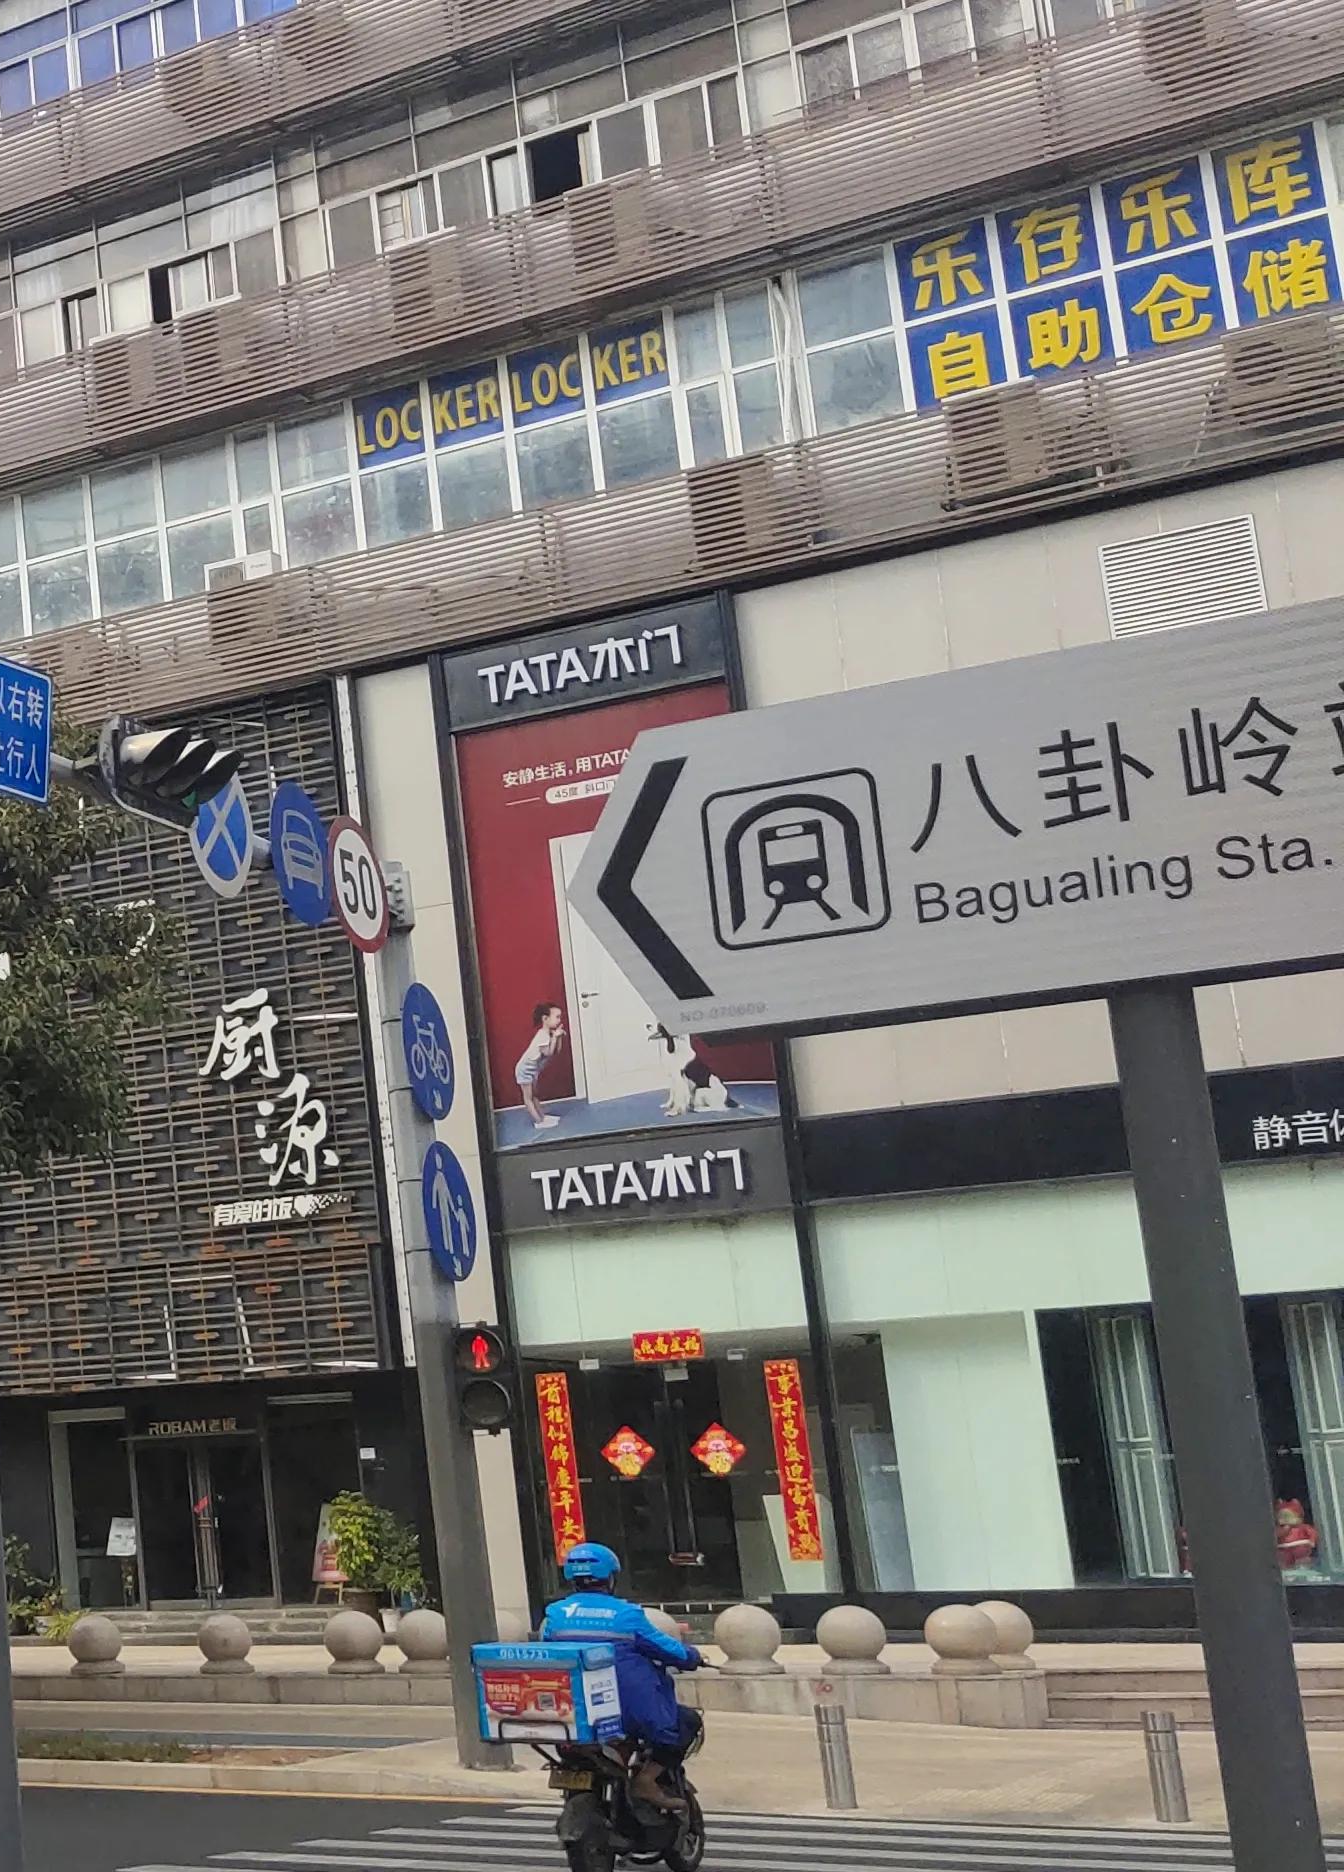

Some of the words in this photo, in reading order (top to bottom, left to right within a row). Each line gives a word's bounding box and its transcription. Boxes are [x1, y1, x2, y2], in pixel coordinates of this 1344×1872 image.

[911, 134, 1313, 312] 乐存乐库
[926, 238, 1331, 400] 自助仓储
[355, 375, 502, 455] LOCKER
[512, 331, 668, 414] LOCKER
[477, 624, 685, 704] TATA木门
[910, 681, 1344, 853] 八卦岭
[338, 847, 377, 920] 50
[913, 854, 1193, 925] Bagualing
[1215, 833, 1333, 880] Sta.
[213, 1196, 293, 1227] 有爱的饭
[529, 1148, 745, 1211] TATA木门
